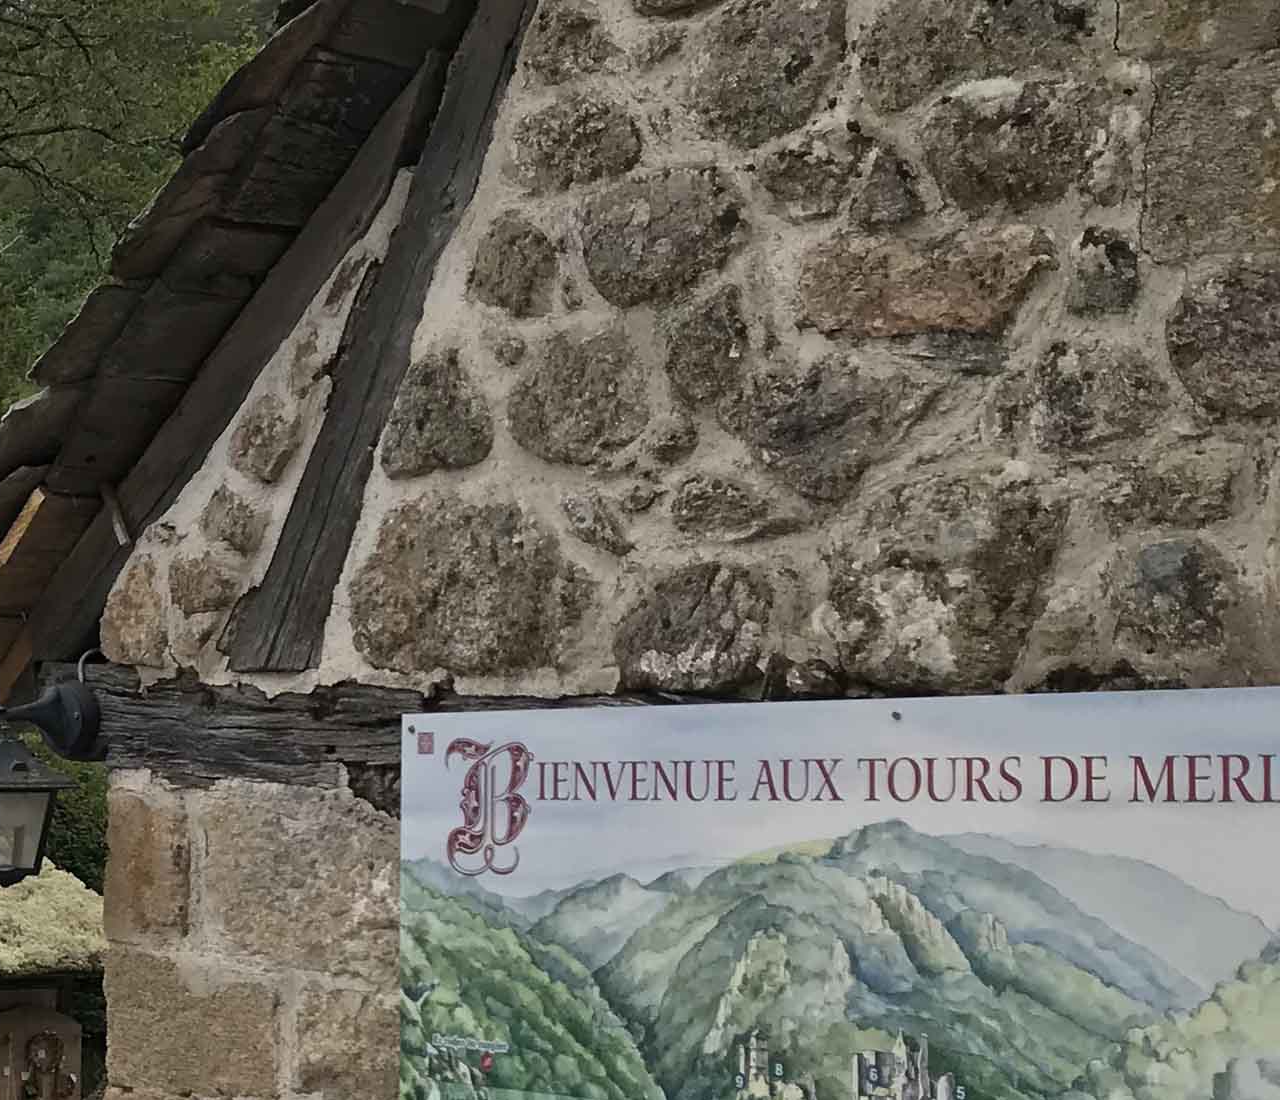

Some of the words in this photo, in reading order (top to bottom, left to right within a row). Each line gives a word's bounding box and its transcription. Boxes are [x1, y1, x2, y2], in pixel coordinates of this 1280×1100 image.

[444, 737, 738, 876] BIENVENUE
[749, 757, 847, 802] AUX
[856, 754, 1024, 803] TOURS
[1039, 754, 1112, 803] DE
[775, 1063, 783, 1076] 8
[869, 1068, 878, 1081] 6
[735, 1075, 744, 1089] 9
[956, 1086, 966, 1099] 5
